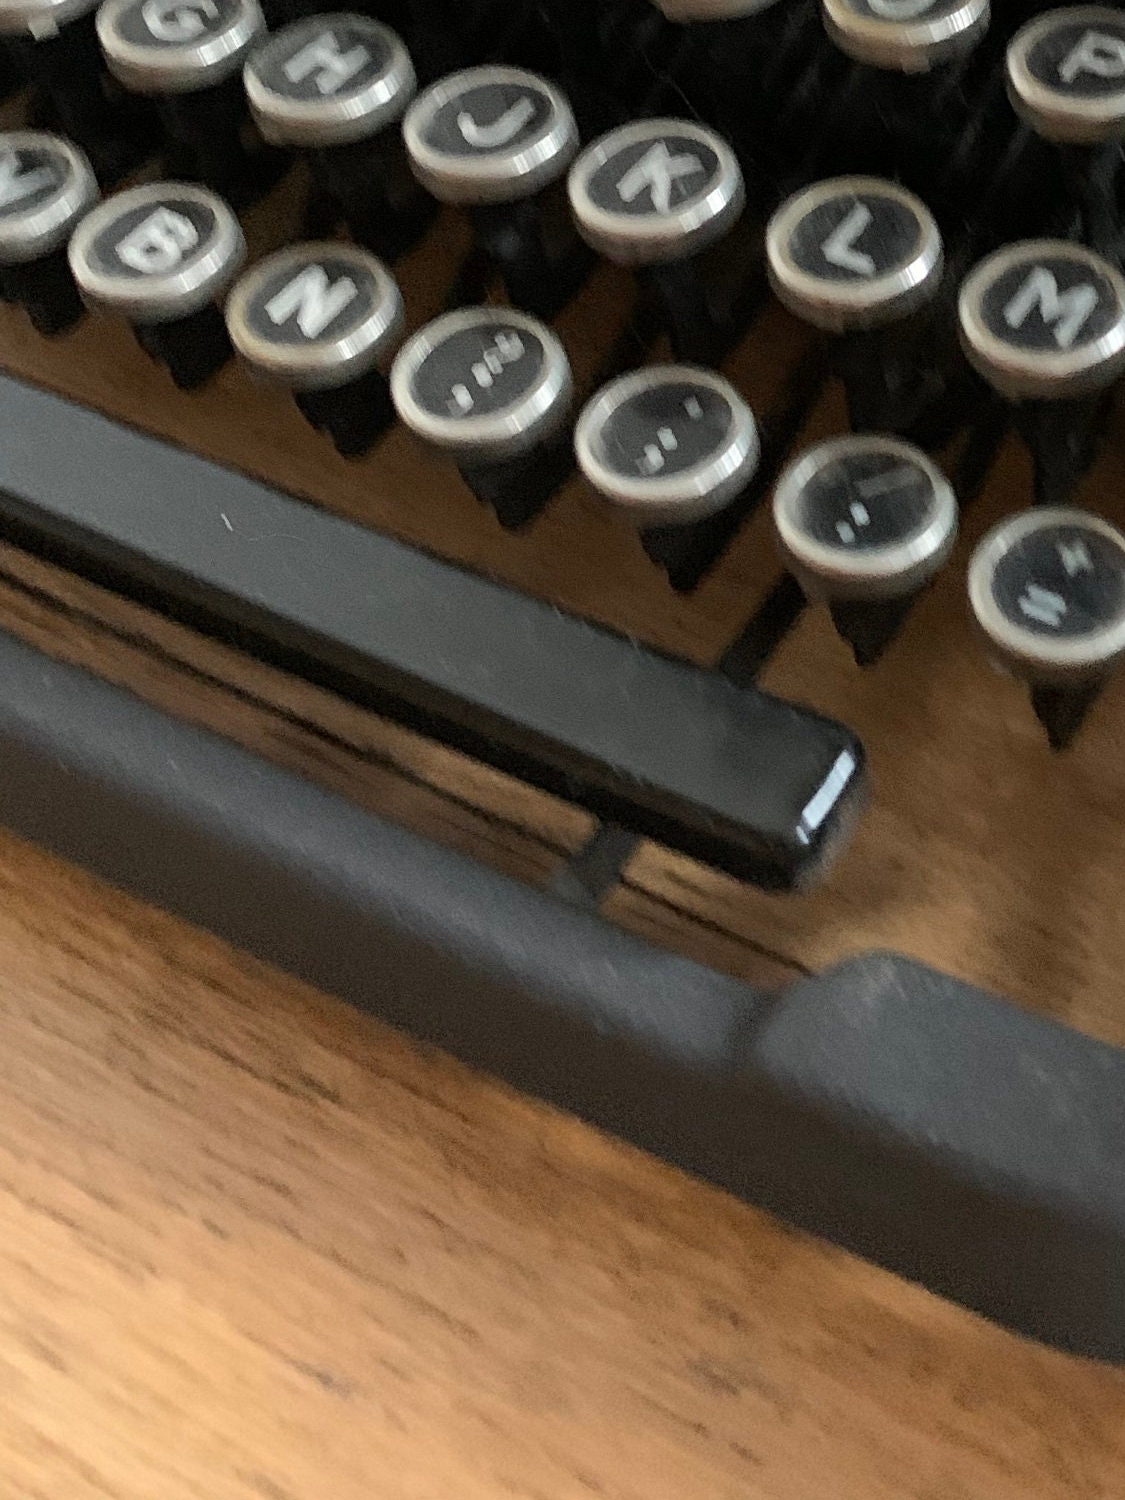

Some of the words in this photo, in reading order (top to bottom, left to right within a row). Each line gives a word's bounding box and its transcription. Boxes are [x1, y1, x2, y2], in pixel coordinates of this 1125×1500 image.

[284, 30, 372, 95] H
[457, 98, 534, 148] J
[615, 140, 706, 215] K
[114, 205, 200, 275] B
[820, 200, 877, 277] L
[263, 264, 359, 340] N
[1002, 265, 1100, 348] M
